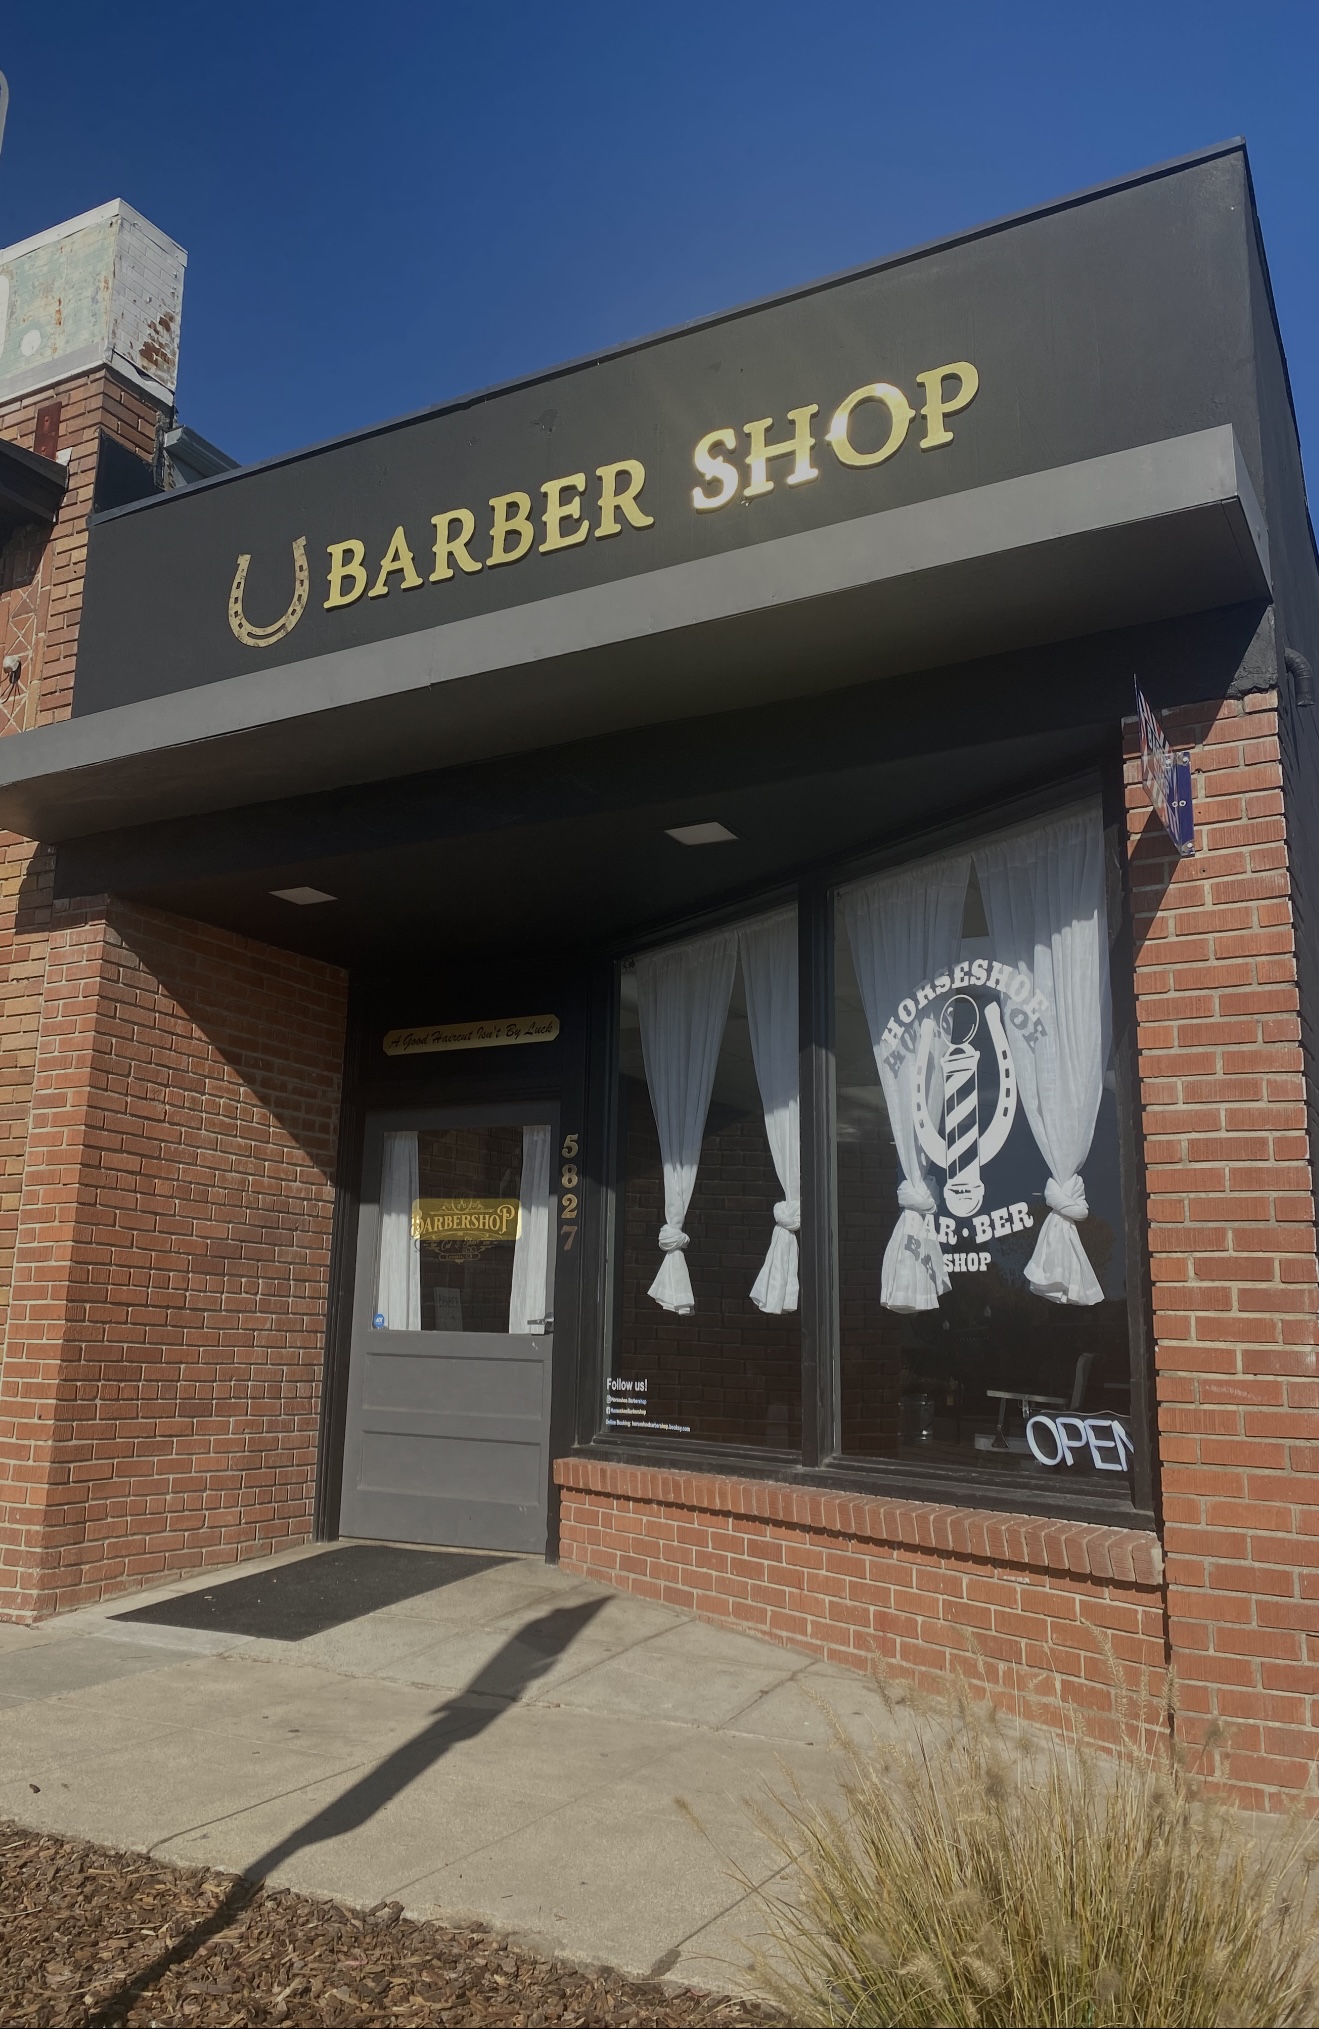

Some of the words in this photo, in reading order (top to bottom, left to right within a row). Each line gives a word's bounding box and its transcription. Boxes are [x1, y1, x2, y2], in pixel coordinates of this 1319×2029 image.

[324, 459, 654, 610] BARBER
[690, 361, 980, 510] SHOP
[881, 958, 1049, 1049] HORSESHOE
[389, 1035, 402, 1049] A
[402, 1032, 429, 1050] Good
[430, 1029, 472, 1044] Haircut
[476, 1025, 502, 1040] Isn't
[505, 1022, 522, 1039] By
[523, 1020, 555, 1036] Luck
[560, 1133, 579, 1251] 5827
[942, 1252, 992, 1273] SHOP
[606, 1377, 633, 1391] Follow
[634, 1378, 648, 1392] us!
